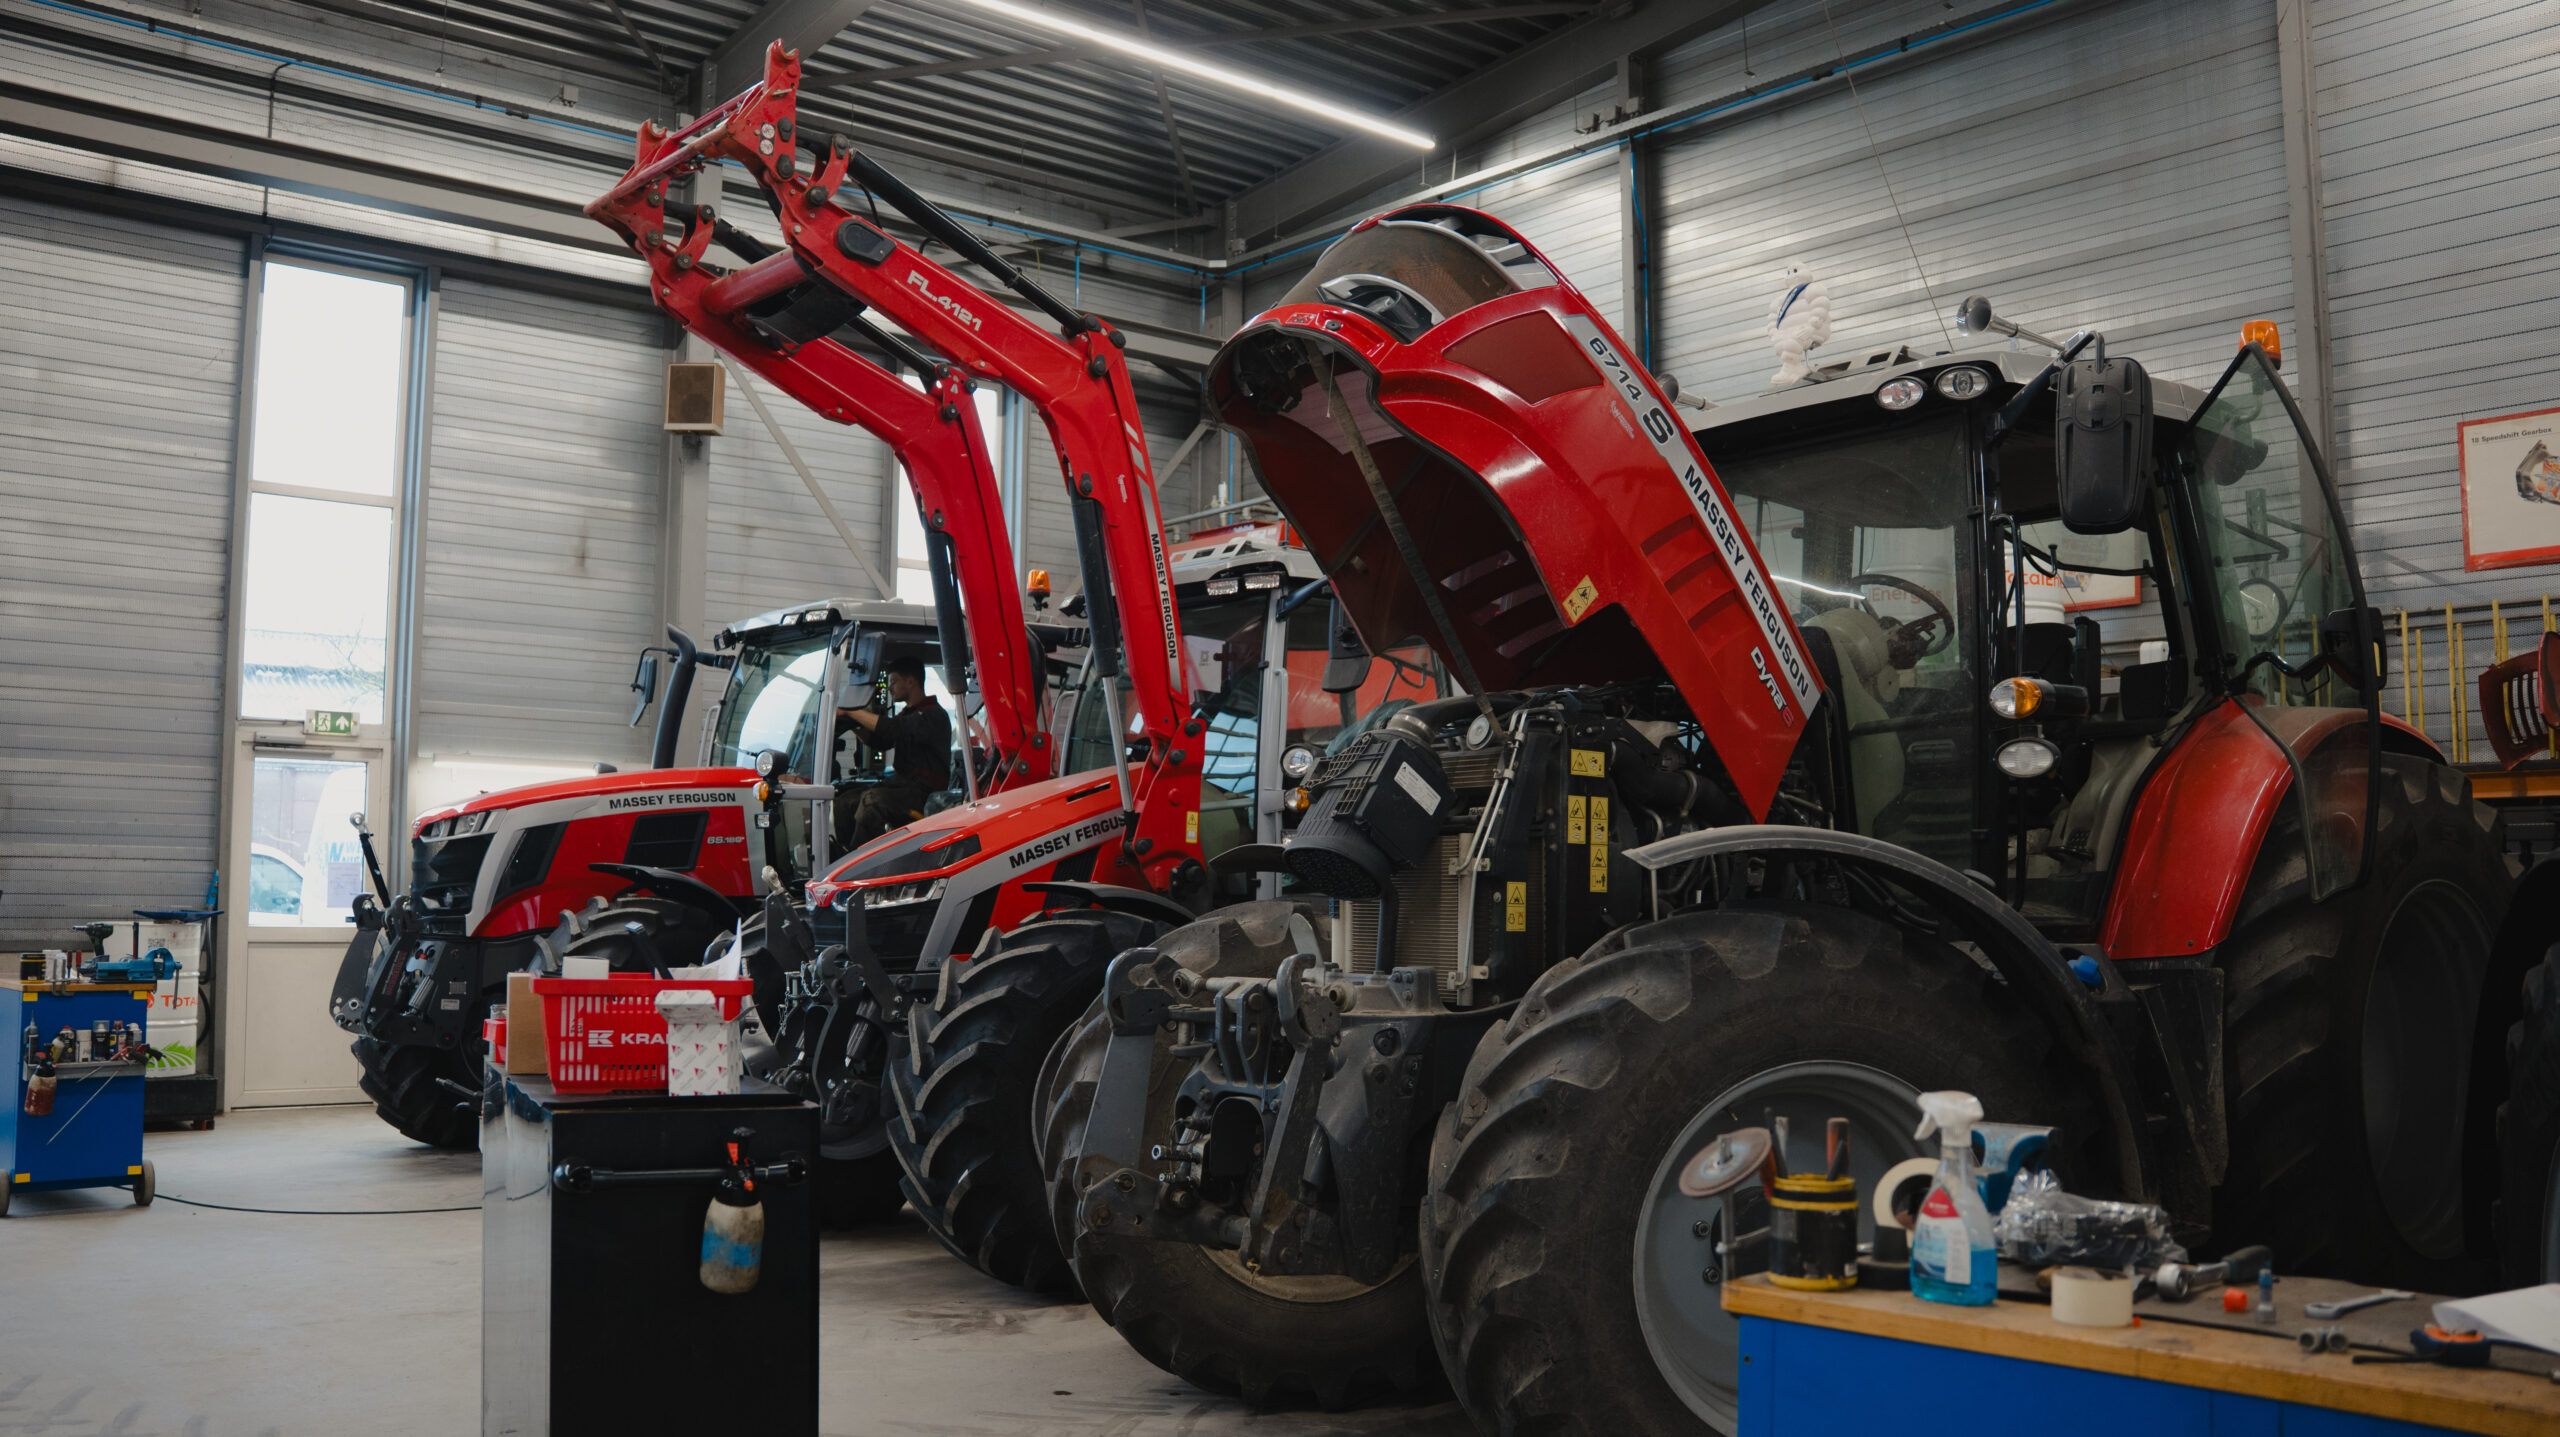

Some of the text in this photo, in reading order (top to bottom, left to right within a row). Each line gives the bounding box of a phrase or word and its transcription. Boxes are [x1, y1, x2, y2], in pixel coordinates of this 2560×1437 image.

[906, 269, 982, 332] FL.4121
[1589, 336, 1641, 402] 6714
[1642, 406, 1674, 446] S
[2481, 431, 2519, 442] Speedshift
[2521, 427, 2552, 436] Gearbox
[1150, 533, 1178, 659] MASSEY FERGUSON
[1684, 464, 1810, 700] MASSEY FERGUSON
[609, 792, 736, 810] MASSEY FERGUSON
[1009, 832, 1071, 869] MASSEY
[621, 1033, 669, 1044] KRA
